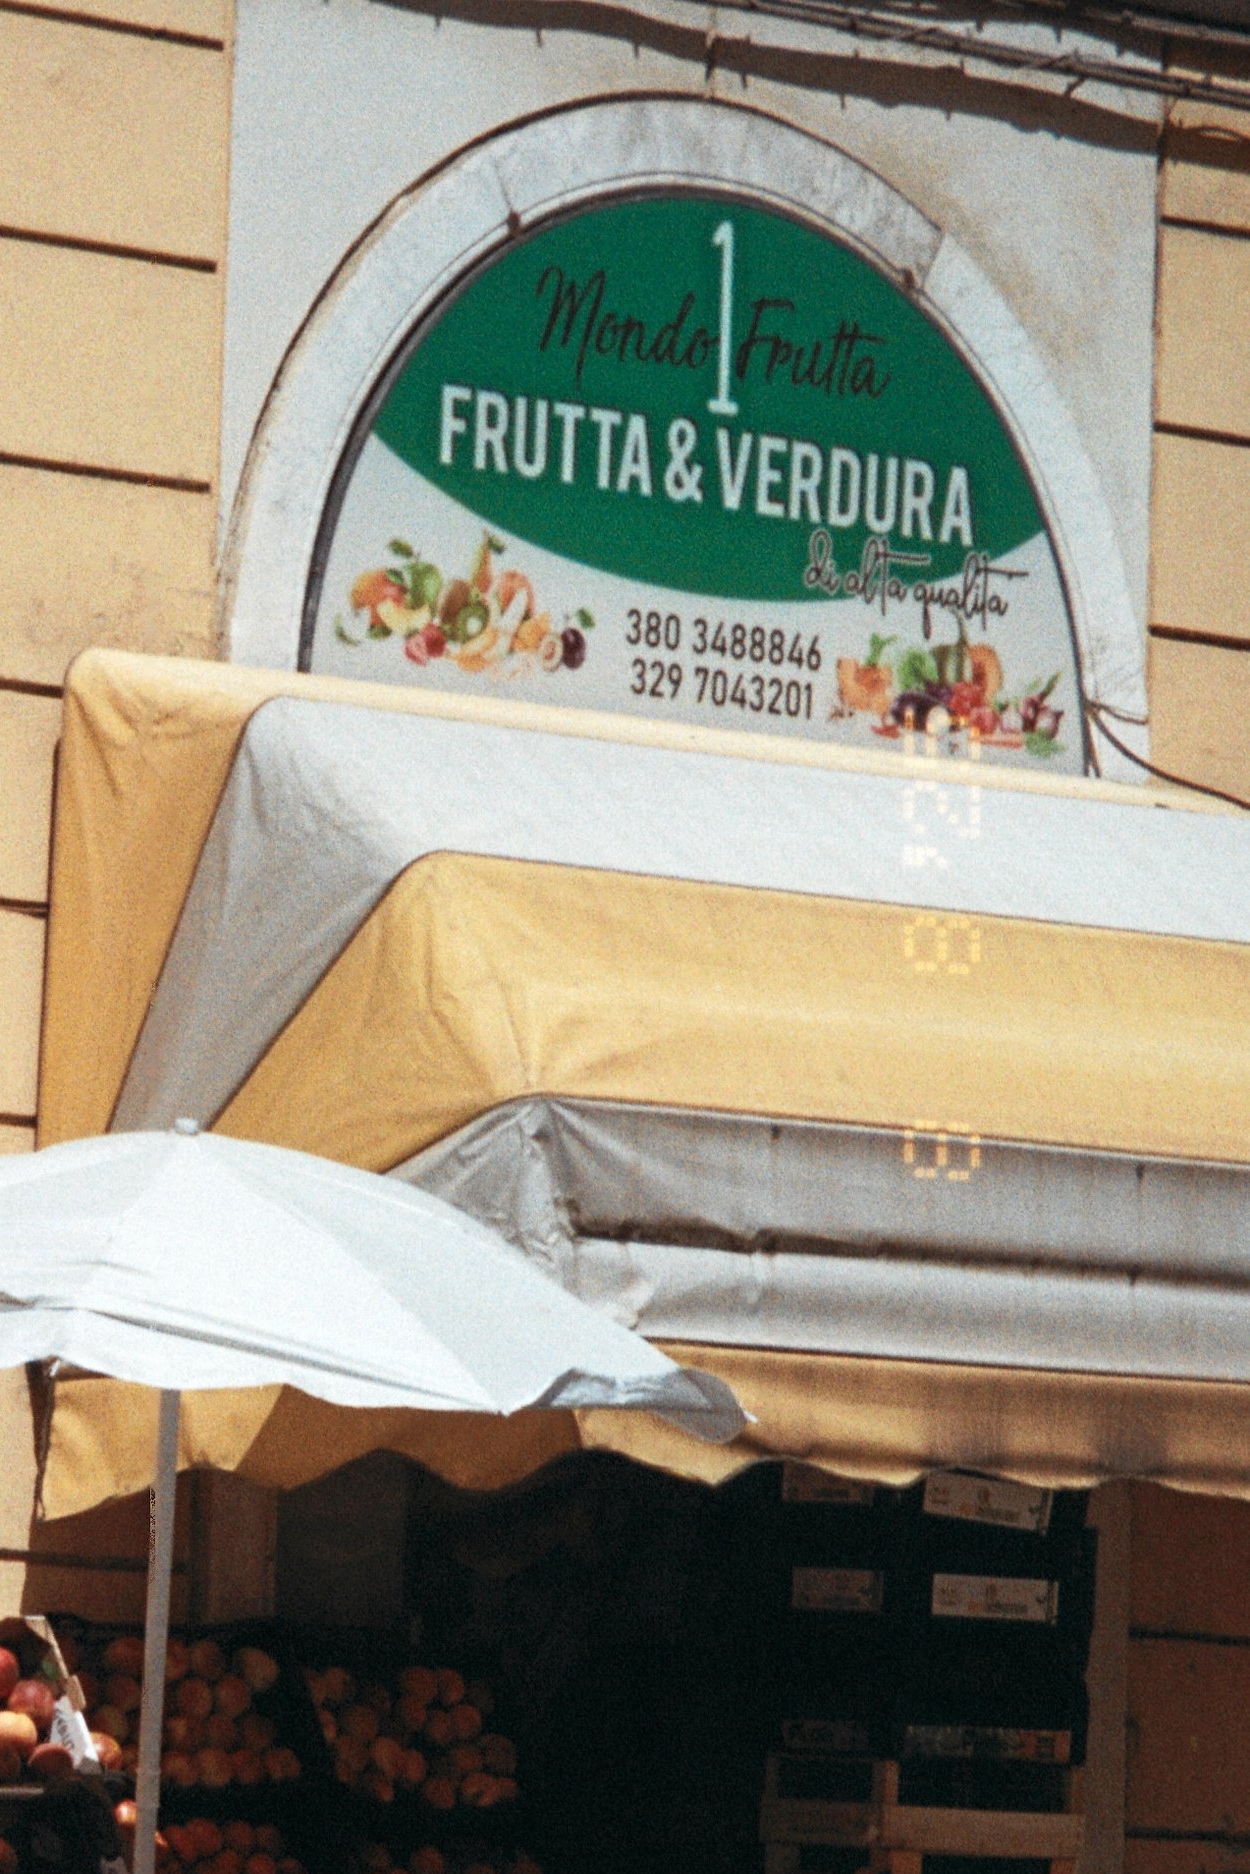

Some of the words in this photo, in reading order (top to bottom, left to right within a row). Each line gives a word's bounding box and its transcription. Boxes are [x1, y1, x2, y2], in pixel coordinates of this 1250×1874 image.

[536, 264, 718, 391] Mondo
[735, 297, 891, 398] Frutta
[439, 384, 652, 497] FRUTTA
[664, 417, 703, 502] &
[716, 426, 974, 547] VERDURA
[803, 529, 840, 595] di
[844, 535, 930, 616] alta
[625, 608, 682, 651] 380
[692, 617, 823, 672] 3488846
[631, 656, 683, 700] 329
[695, 666, 814, 720] 7043201
